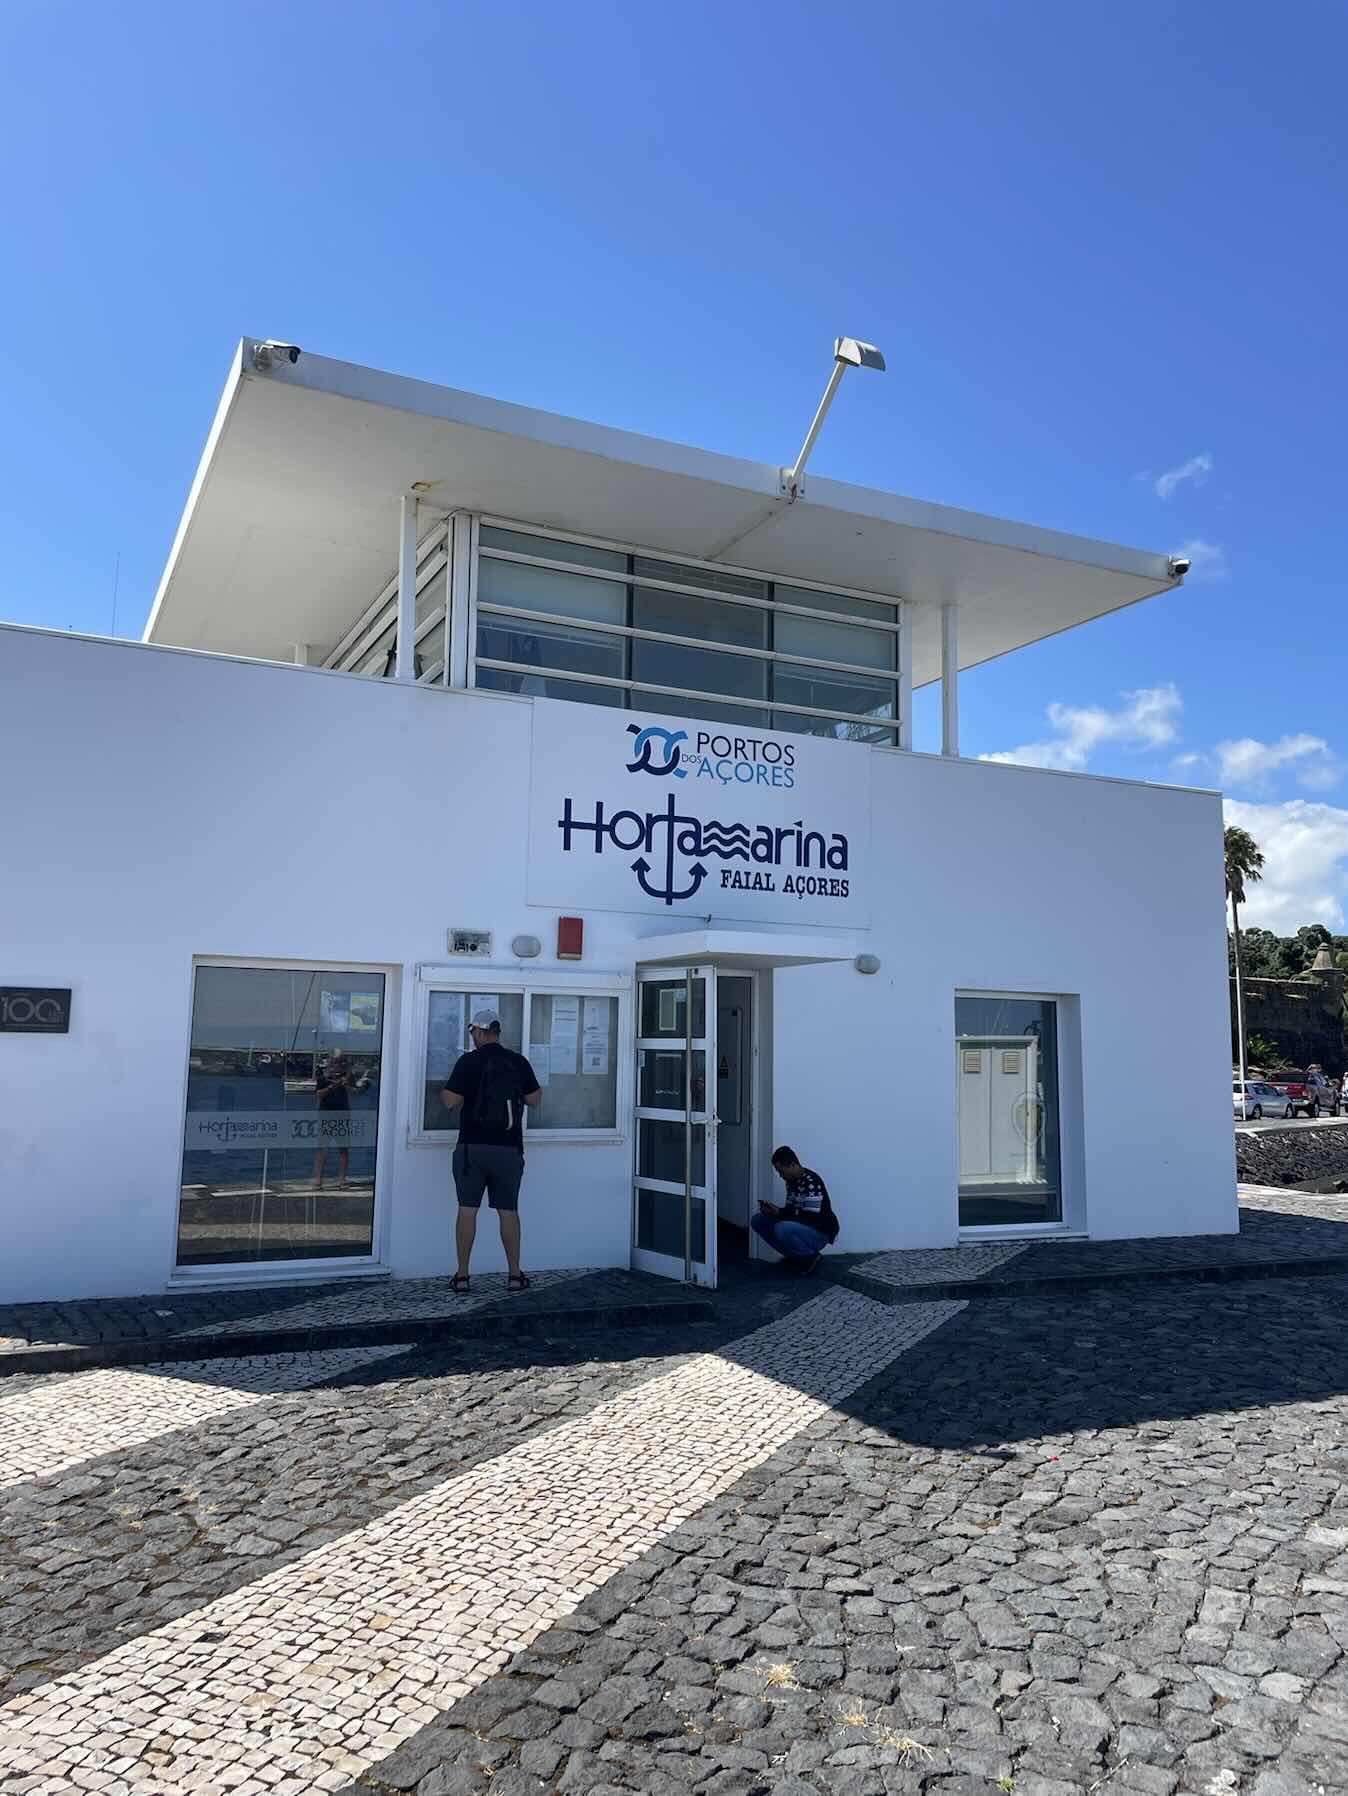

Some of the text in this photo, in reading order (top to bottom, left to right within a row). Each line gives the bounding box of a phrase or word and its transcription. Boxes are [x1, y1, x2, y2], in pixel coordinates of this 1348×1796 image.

[697, 732, 795, 766] PORTOS
[681, 753, 794, 788] DOS AÇORES
[720, 869, 849, 900] FAIAL AÇORES
